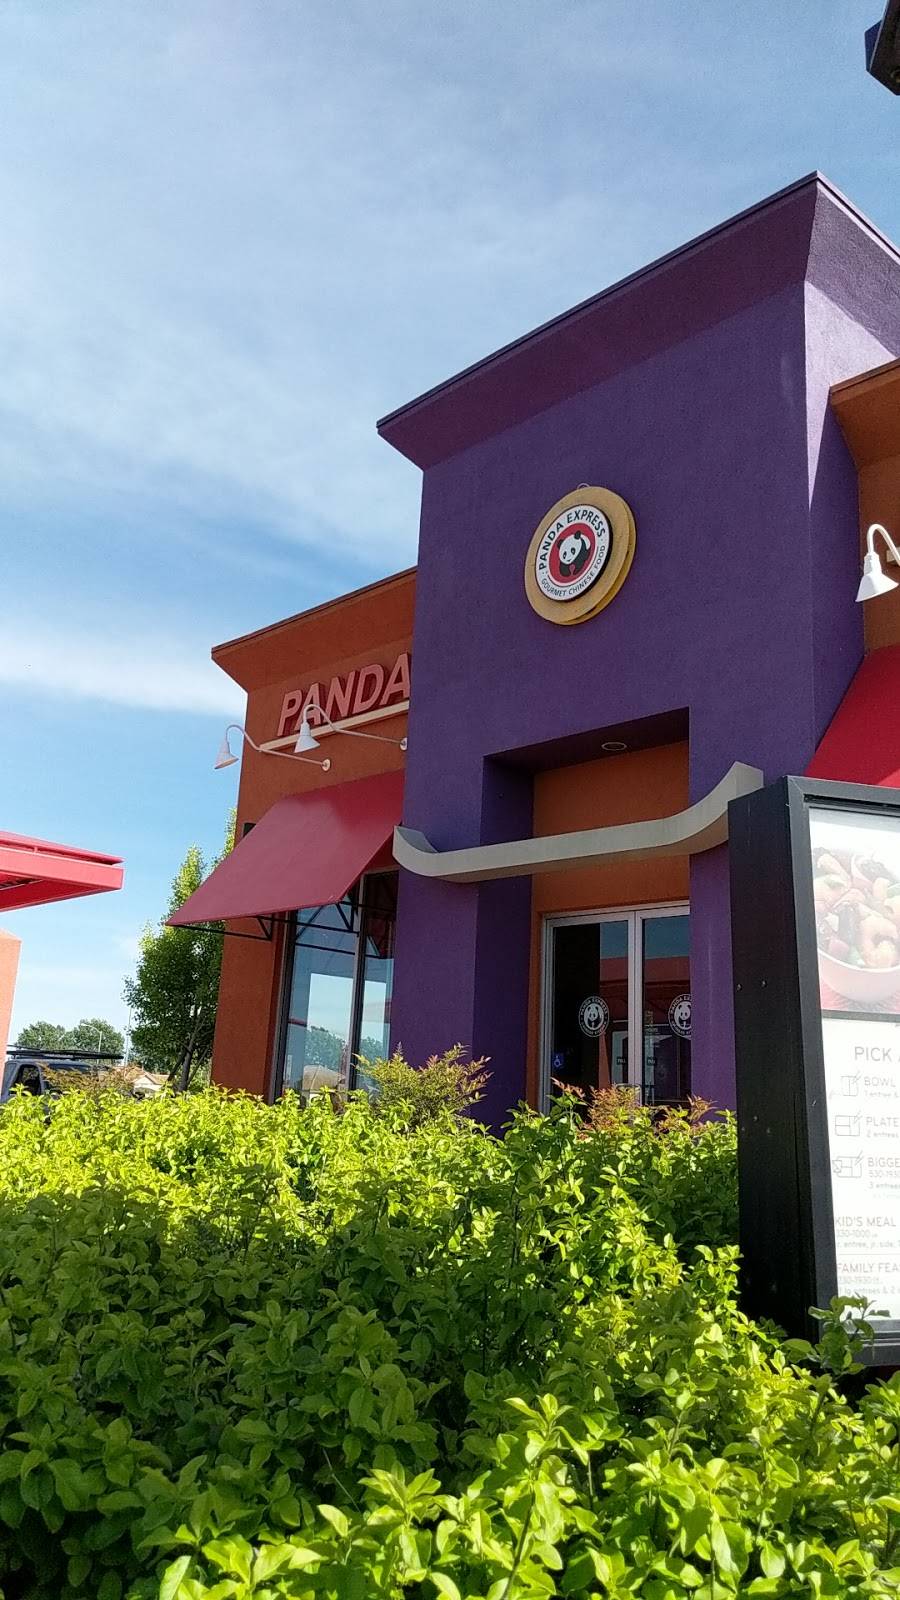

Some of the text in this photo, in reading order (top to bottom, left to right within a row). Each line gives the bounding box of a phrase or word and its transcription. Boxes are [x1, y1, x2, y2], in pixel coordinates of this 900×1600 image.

[538, 509, 606, 570] PANDA EXPRESS
[541, 545, 606, 597] GOURMET CHINESE FOOD
[277, 652, 411, 737] PANDA
[854, 1046, 892, 1062] PICK
[864, 1076, 896, 1087] BOWL
[866, 1116, 900, 1127] PLATE
[867, 1157, 900, 1168] BIGGE
[835, 1216, 896, 1227] KID'S MEAL
[837, 1262, 900, 1273] FAMILY FEA
